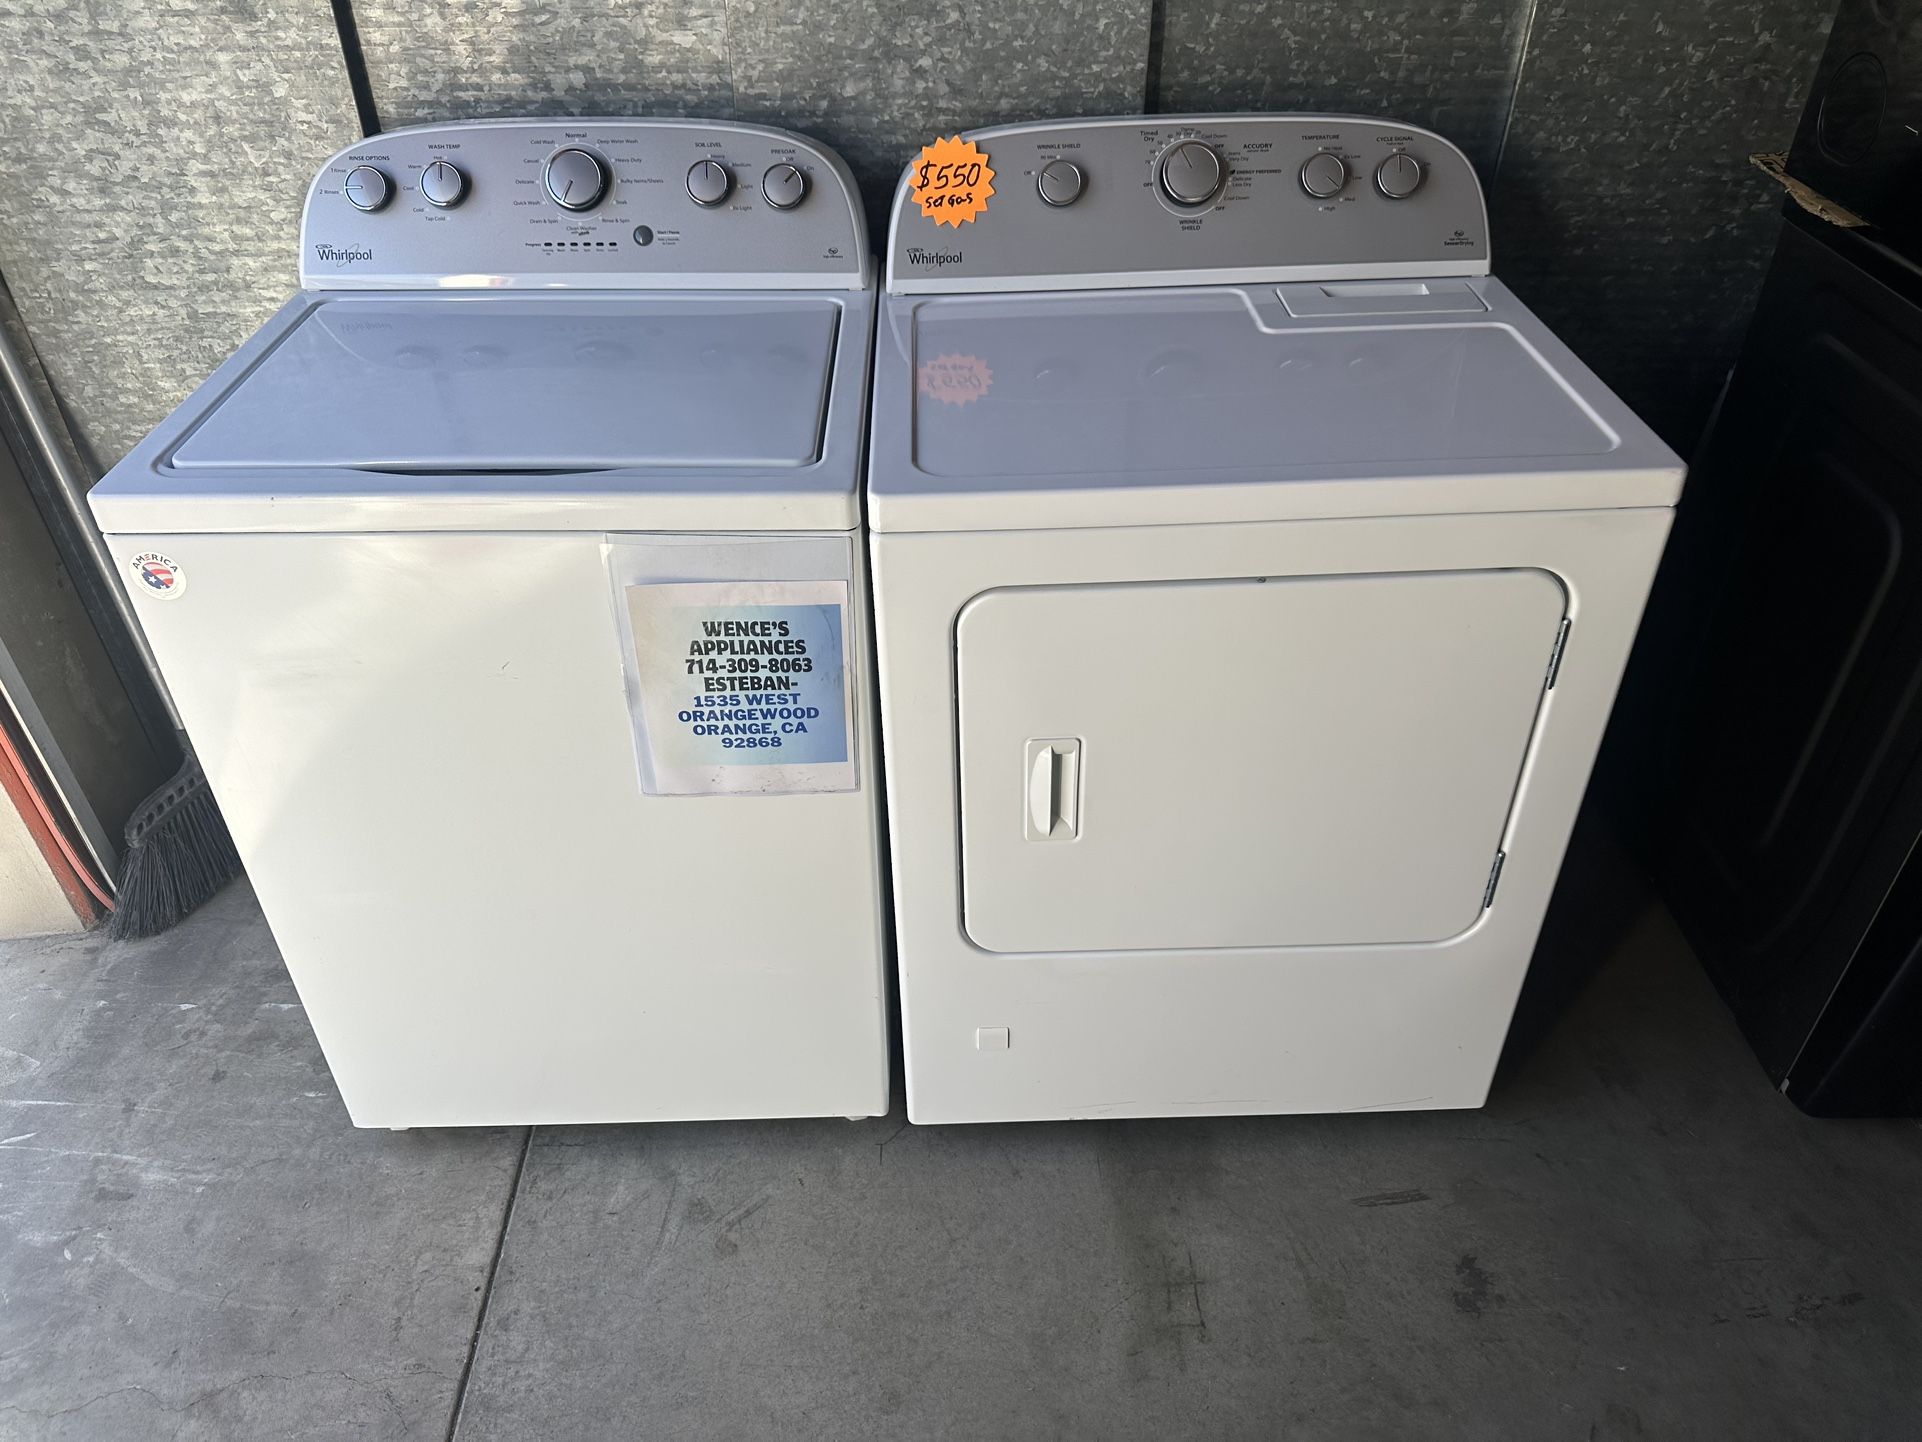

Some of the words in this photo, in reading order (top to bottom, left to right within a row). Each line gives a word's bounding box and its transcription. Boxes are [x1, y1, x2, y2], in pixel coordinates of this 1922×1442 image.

[916, 160, 981, 191] $550
[317, 249, 372, 263] Whirlpool
[908, 252, 962, 267] Whirlpool
[132, 553, 178, 573] AMERICA
[689, 639, 807, 656] APPLIANCES
[685, 658, 812, 674] 714-309-8063
[704, 676, 798, 692] ESTEBAN-
[693, 694, 741, 707] 1535
[744, 693, 801, 706] WEST
[678, 707, 820, 722] ORANGEWOOD
[692, 722, 778, 736] ORANGE,
[781, 722, 808, 734] CA
[721, 736, 783, 748] 92868
